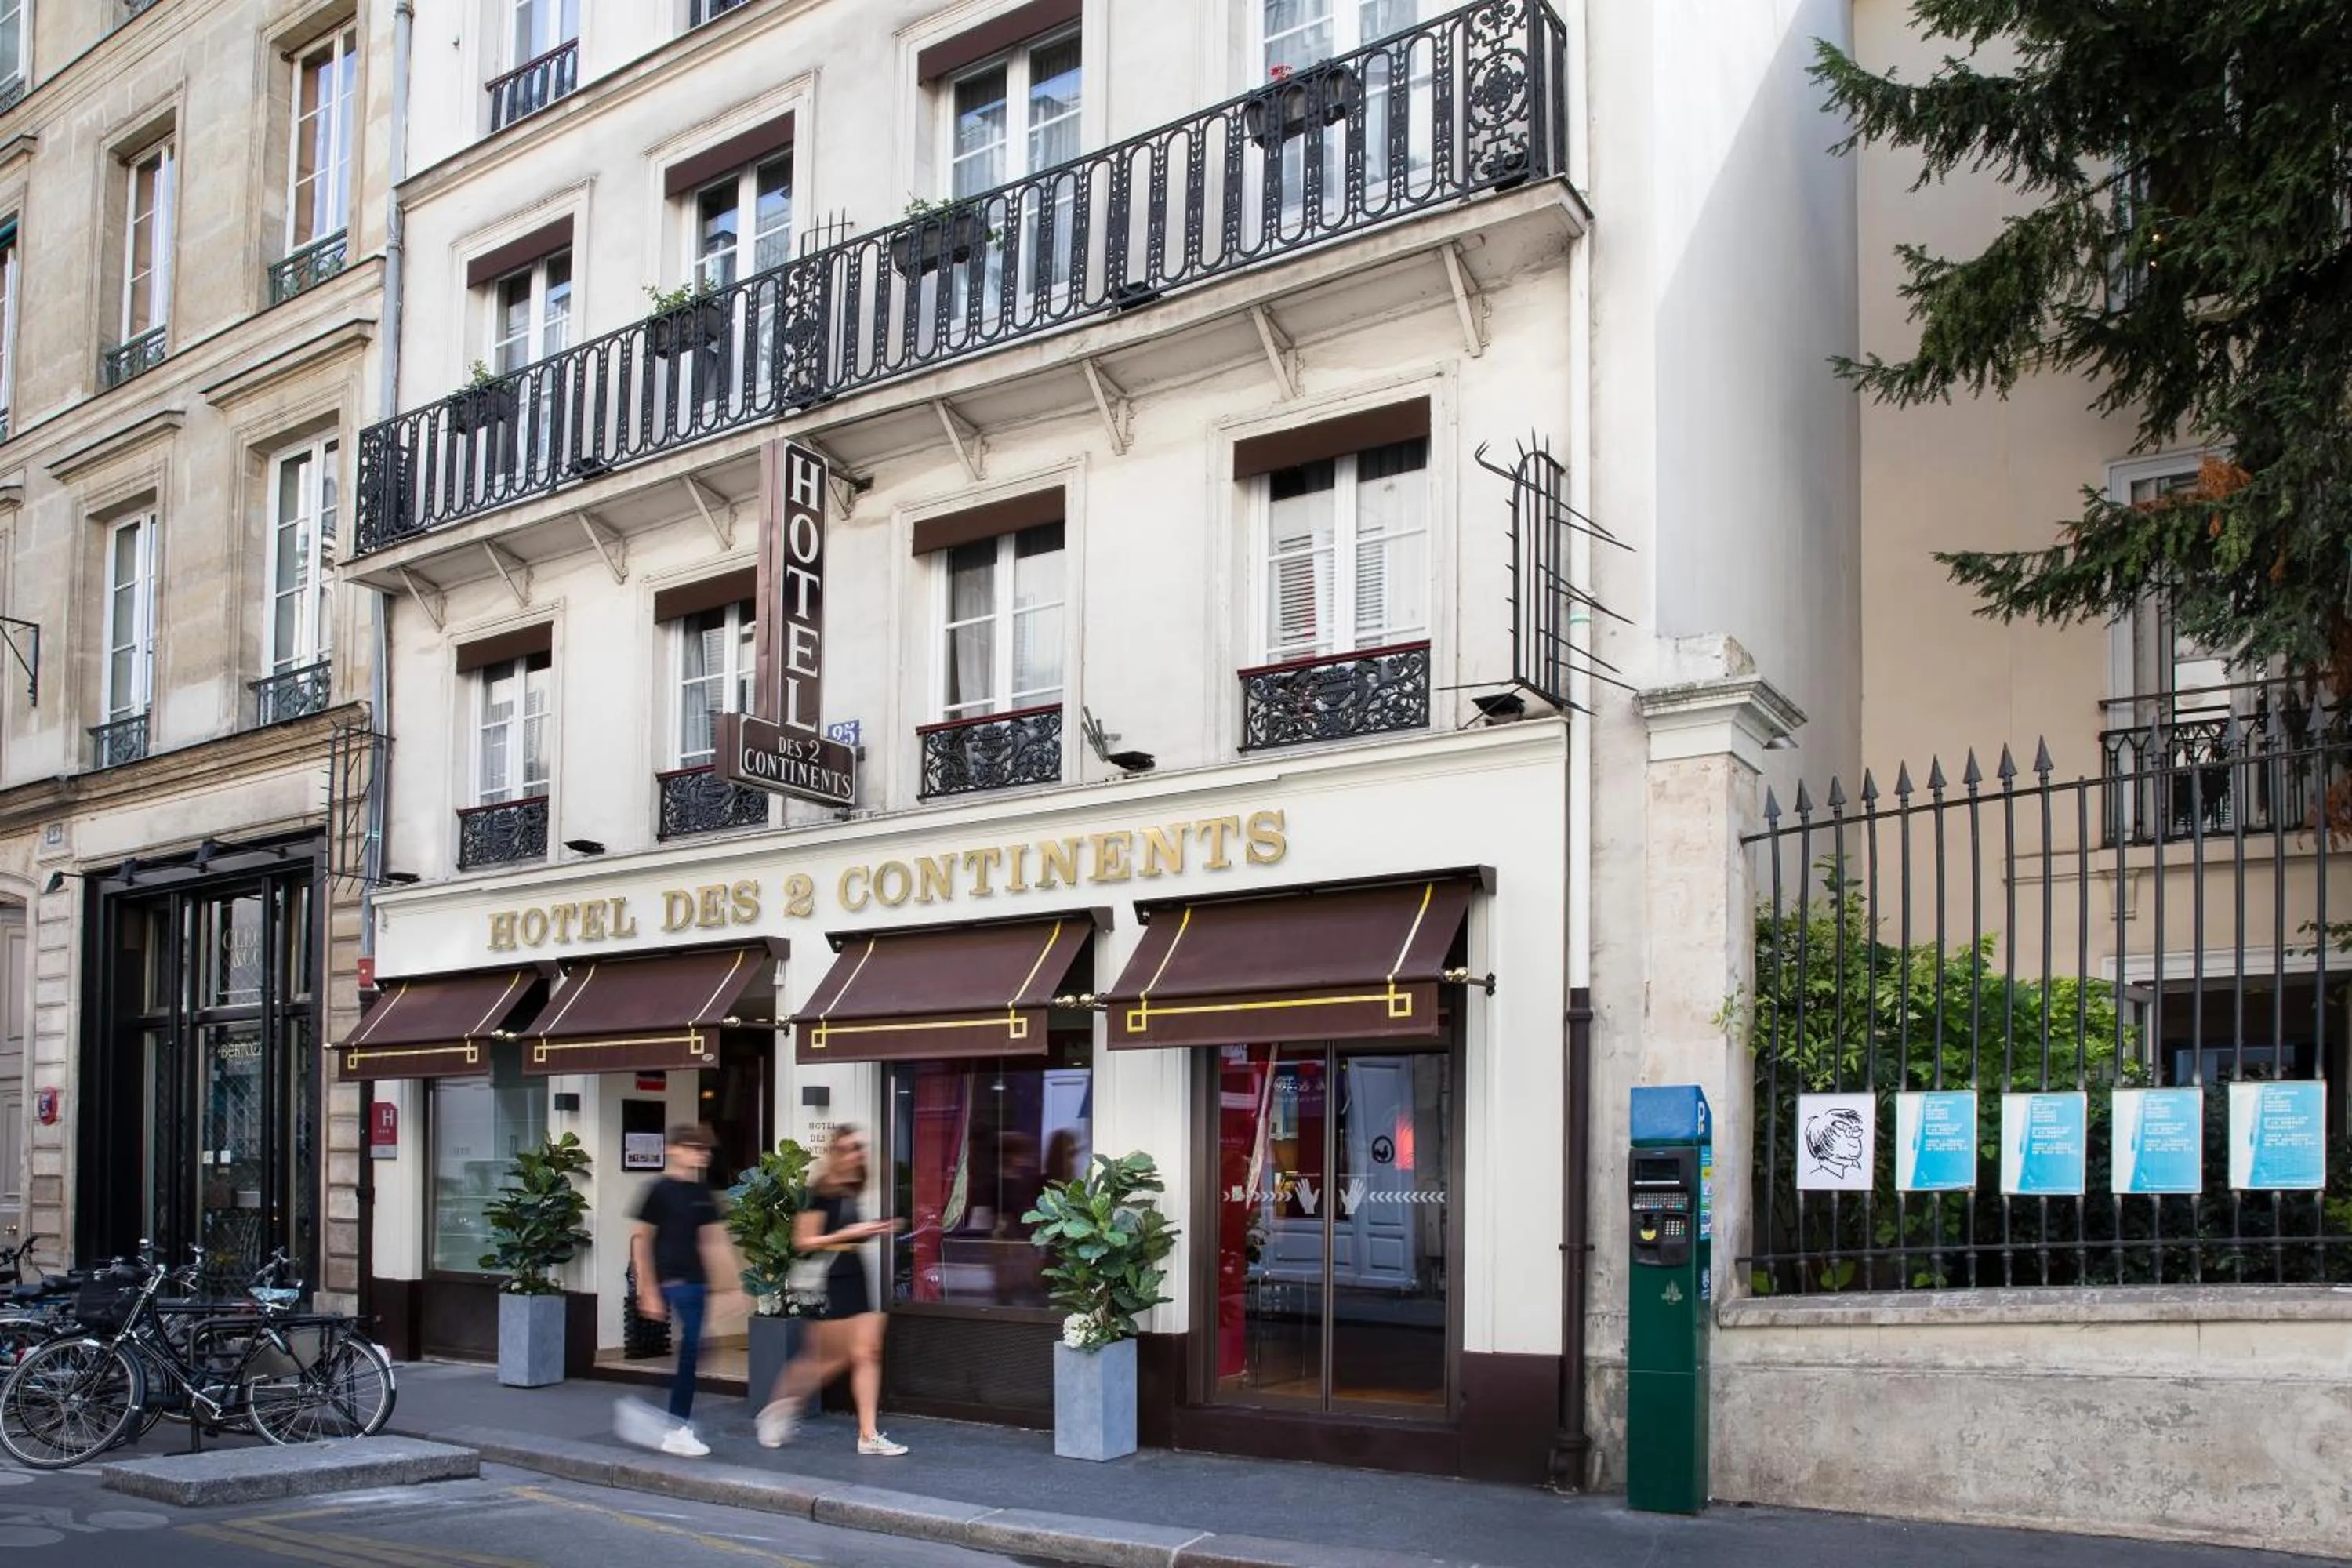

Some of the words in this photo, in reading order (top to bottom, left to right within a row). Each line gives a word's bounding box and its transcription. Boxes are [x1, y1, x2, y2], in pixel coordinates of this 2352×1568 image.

[786, 455, 821, 732] HOTEL
[744, 747, 851, 797] CONTINENTS
[779, 736, 802, 758] DES
[808, 739, 820, 764] 2
[488, 896, 637, 951] HOTEL
[661, 879, 760, 931] DES
[784, 873, 814, 918] 2
[837, 809, 1287, 912] CONTINENTS
[382, 1109, 394, 1127] H
